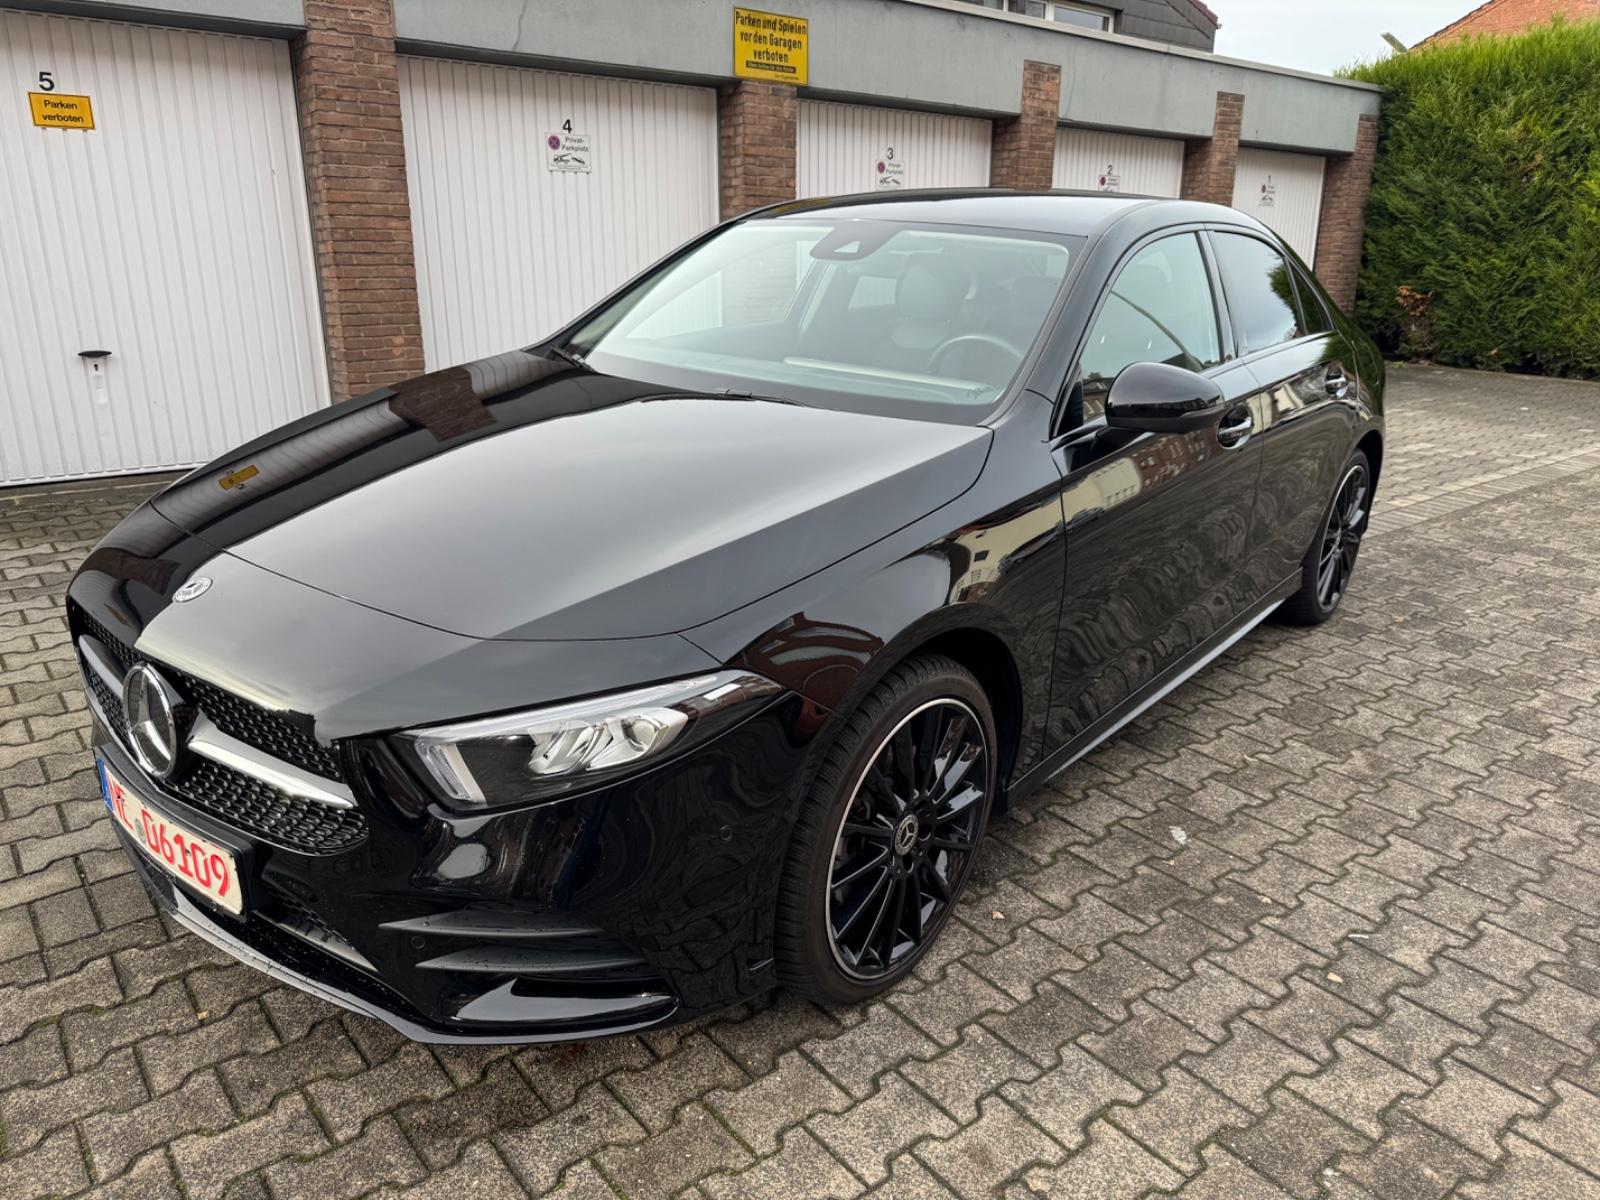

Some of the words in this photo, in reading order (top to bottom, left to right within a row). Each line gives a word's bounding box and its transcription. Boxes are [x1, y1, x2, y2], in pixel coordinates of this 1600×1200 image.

[735, 11, 761, 28] Parken
[762, 17, 777, 31] und
[778, 19, 807, 35] Spielen
[740, 31, 752, 42] vor
[753, 31, 767, 45] den
[769, 33, 802, 51] Garagen
[753, 48, 788, 63] verboten
[38, 71, 55, 91] 5
[43, 99, 78, 110] Parken
[42, 113, 84, 123] verboten
[562, 119, 573, 134] 4
[886, 147, 894, 160] 3
